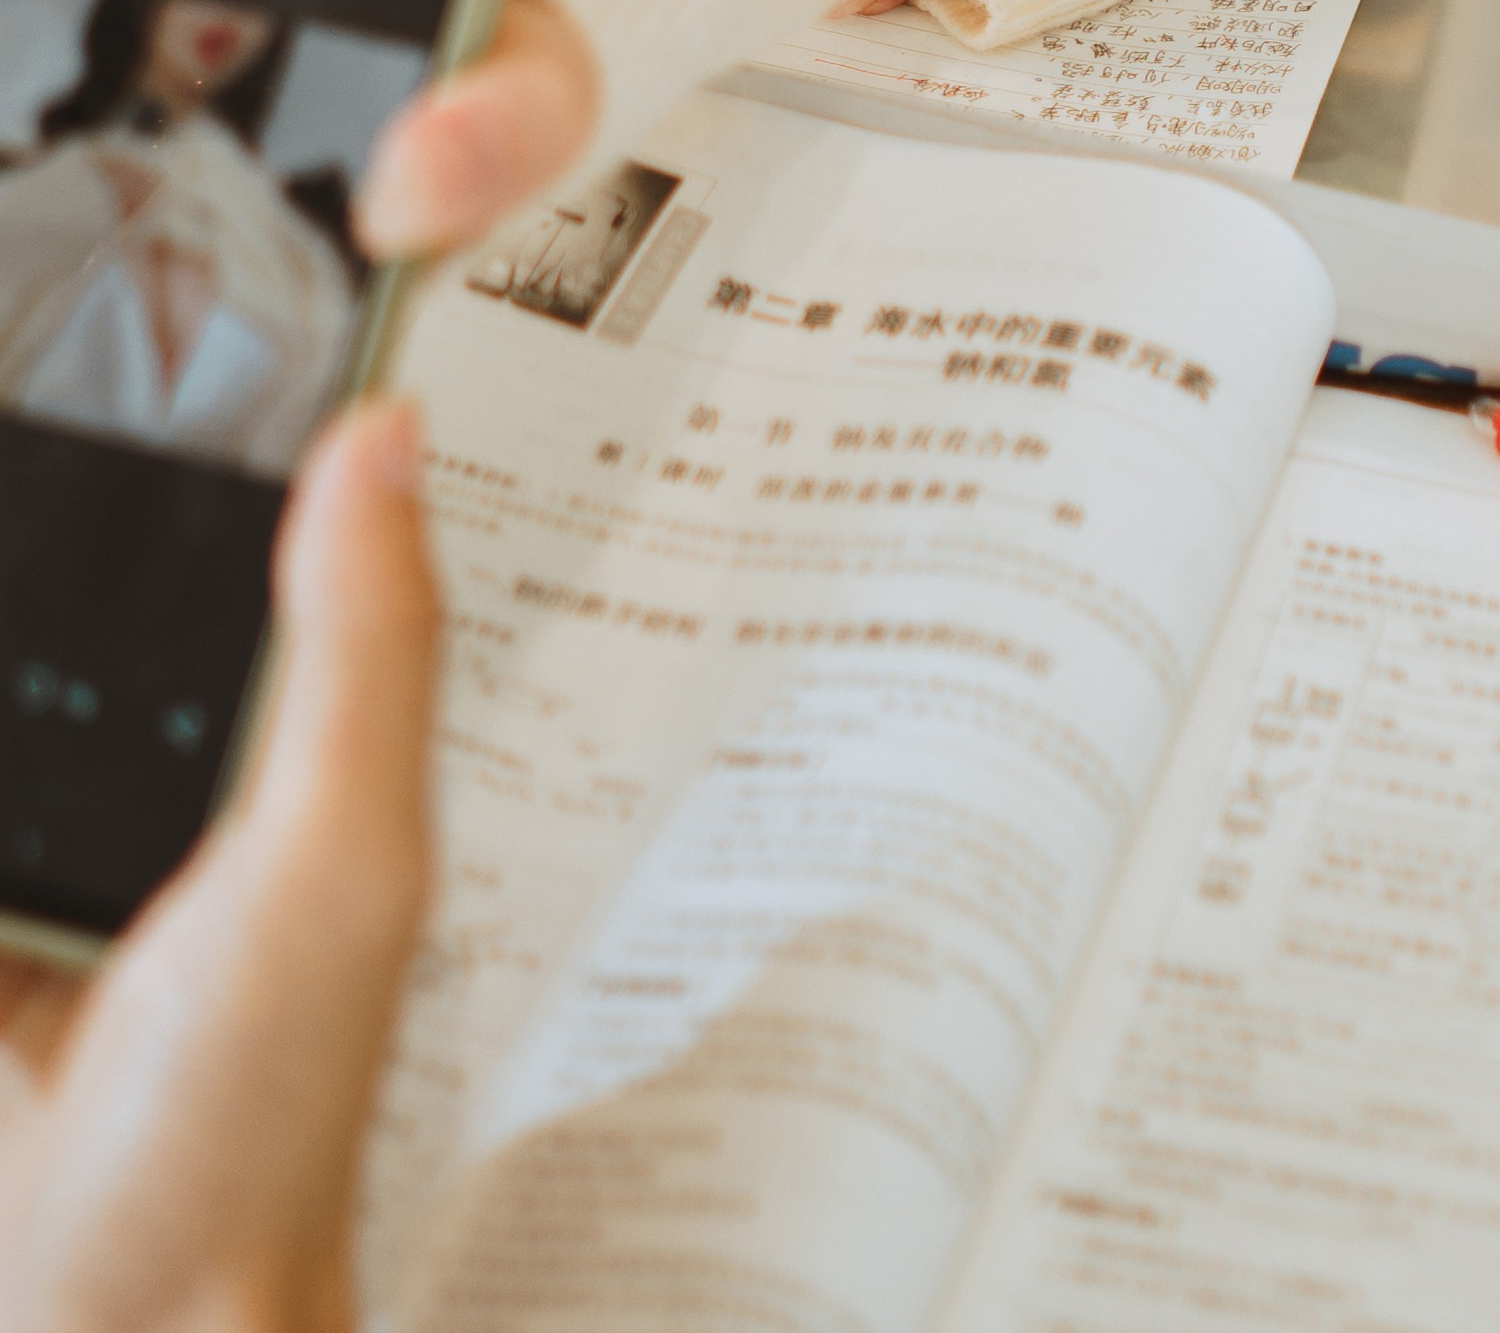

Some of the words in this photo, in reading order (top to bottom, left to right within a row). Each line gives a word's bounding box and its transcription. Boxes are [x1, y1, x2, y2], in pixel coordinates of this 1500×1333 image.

[705, 275, 844, 332] 第二章
[862, 303, 1217, 403] 海水中的重要元素
